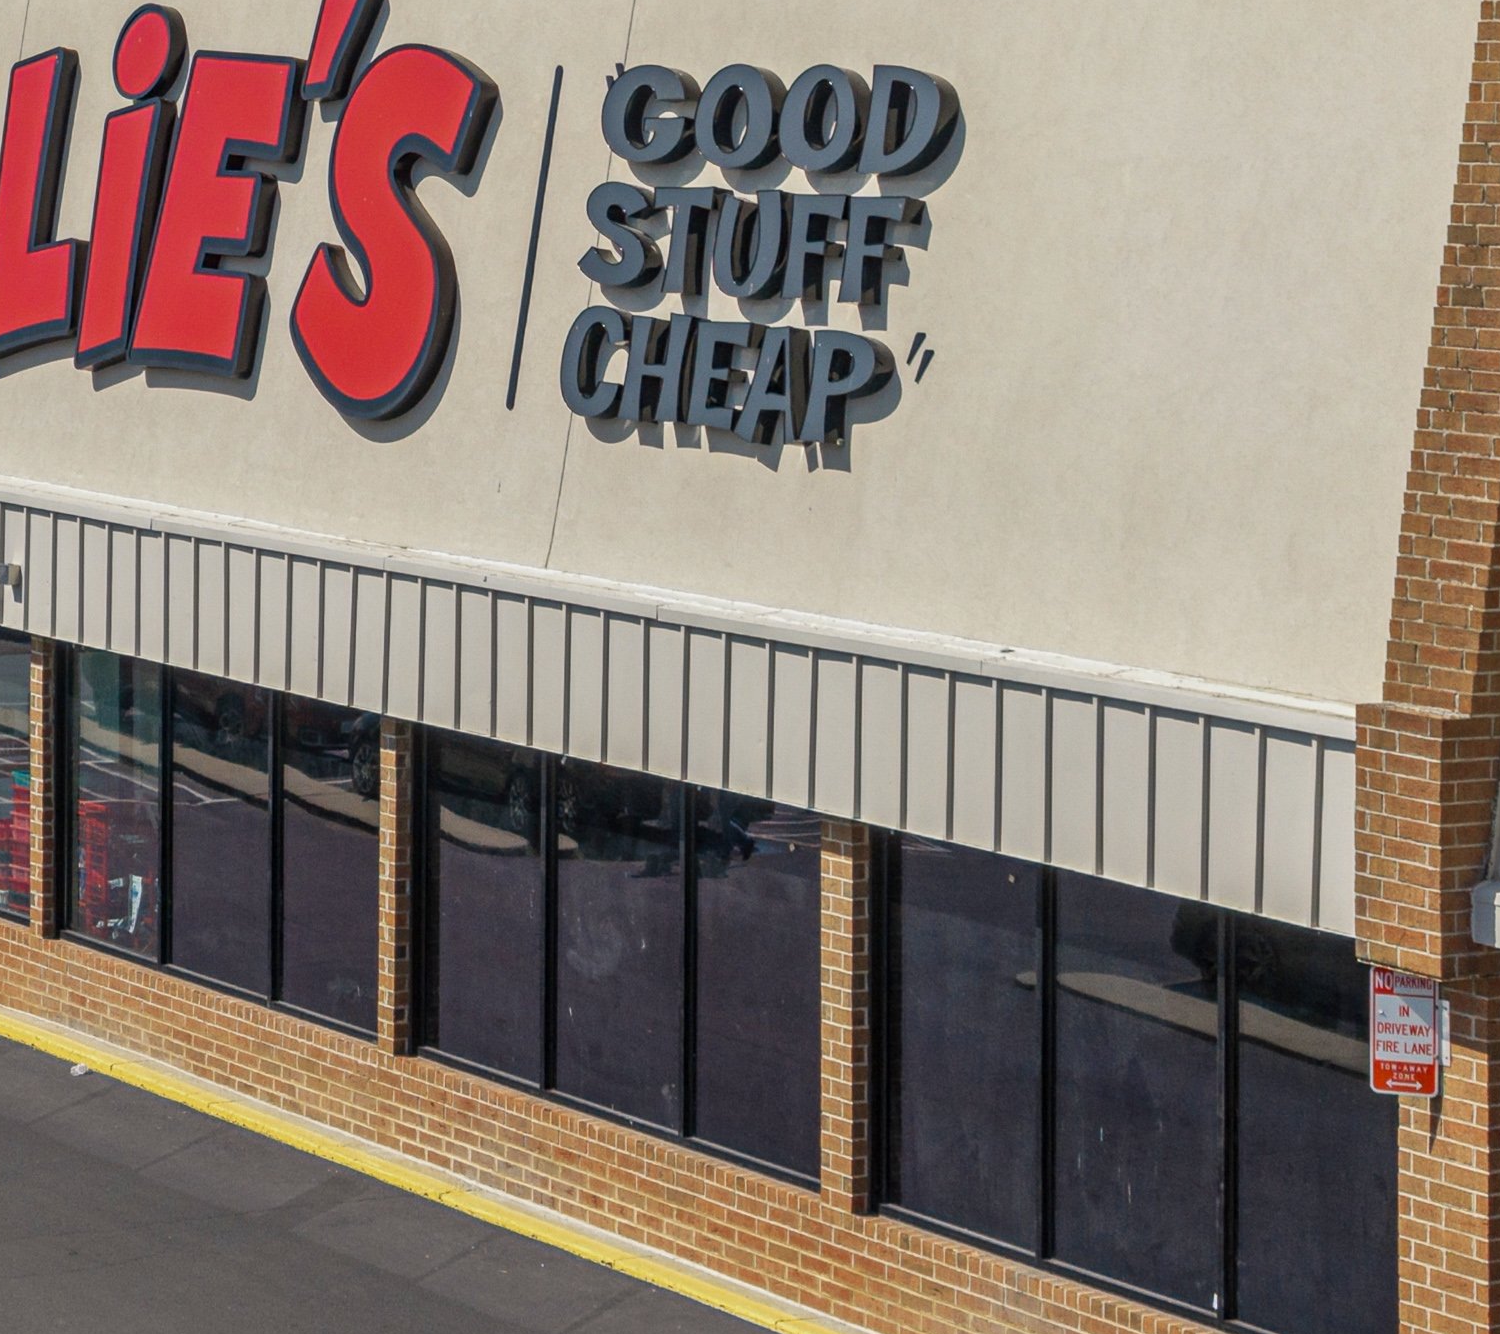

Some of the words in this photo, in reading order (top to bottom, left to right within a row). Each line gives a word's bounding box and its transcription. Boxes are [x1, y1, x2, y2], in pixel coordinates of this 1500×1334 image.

[578, 183, 924, 306] STUFF
[1375, 971, 1393, 990] NO
[1395, 975, 1432, 990] PARKING
[1399, 1005, 1410, 1018] IN
[1377, 1022, 1432, 1037] DRIVEWAY
[1376, 1039, 1399, 1053] FIRE
[1404, 1042, 1432, 1056] LANE
[1380, 1062, 1429, 1074] TOW-AWAY
[1392, 1071, 1416, 1081] ZONE
